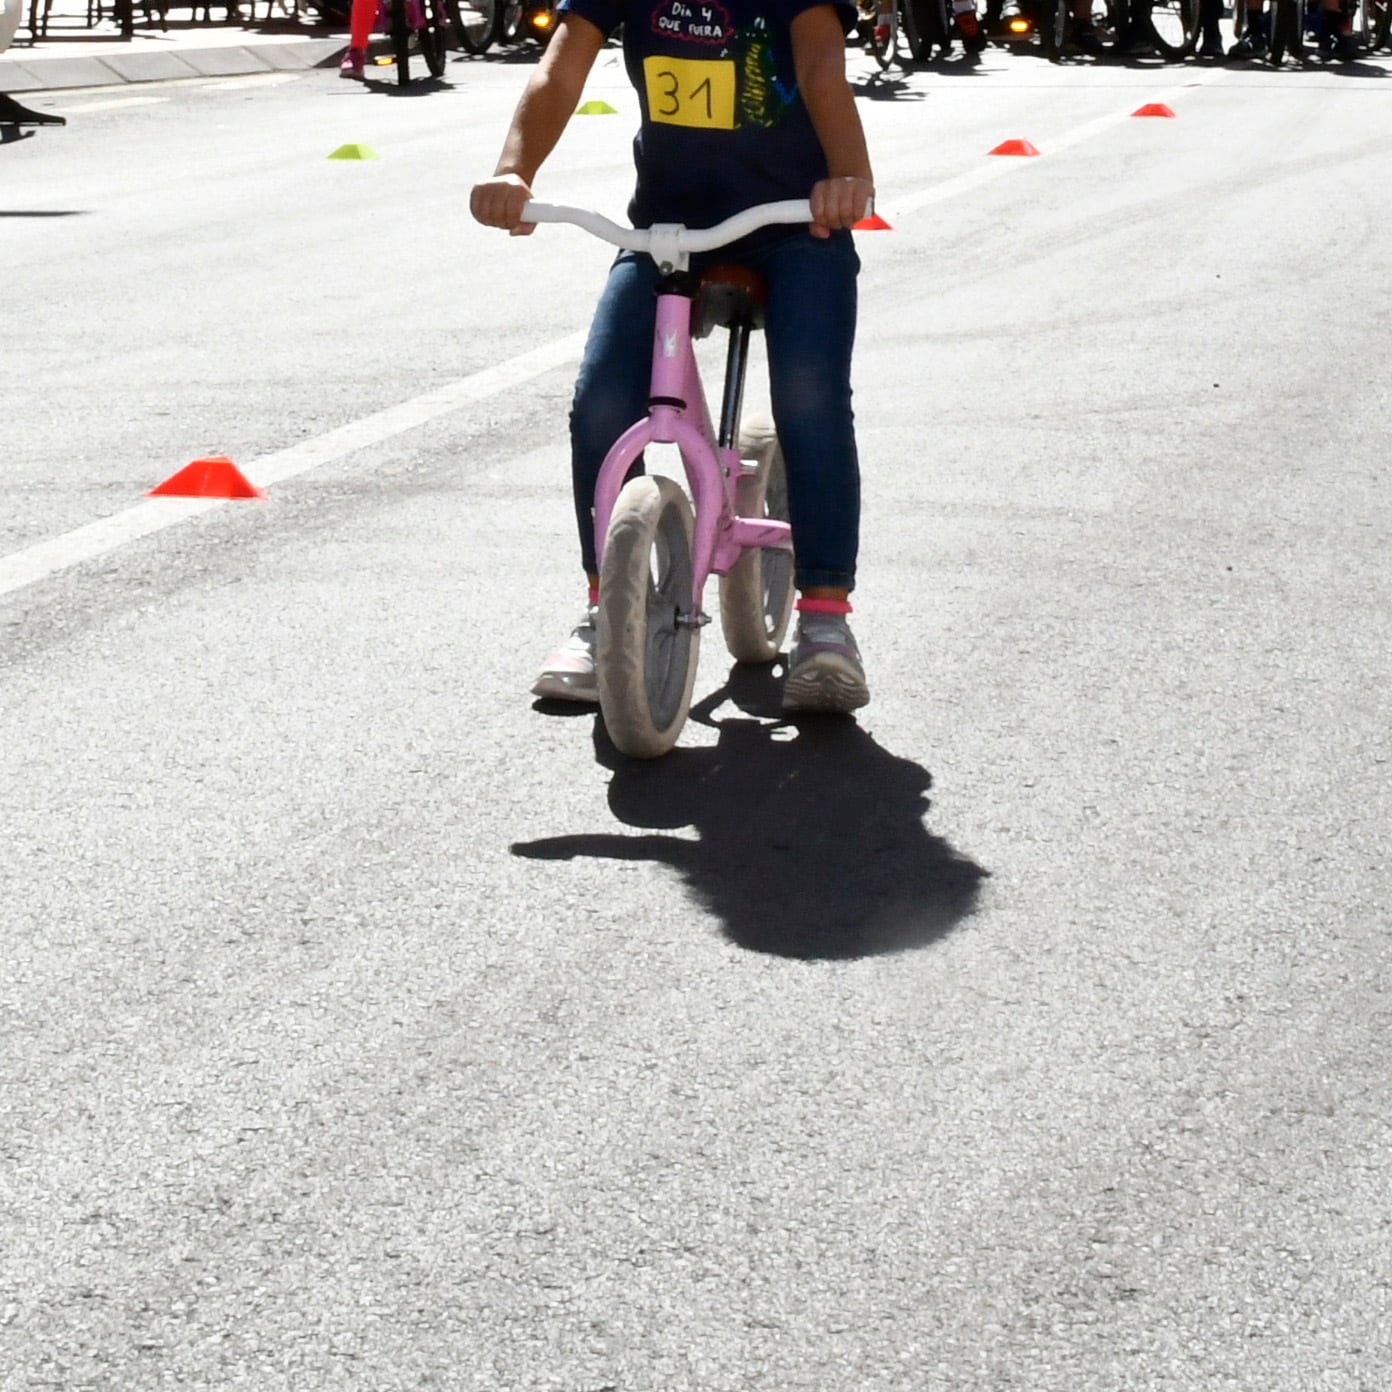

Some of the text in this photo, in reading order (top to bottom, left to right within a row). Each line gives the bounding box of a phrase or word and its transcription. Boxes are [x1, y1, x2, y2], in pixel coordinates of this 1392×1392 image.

[702, 7, 712, 22] 4
[658, 15, 722, 38] QUE FUERA
[657, 71, 712, 119] 31
